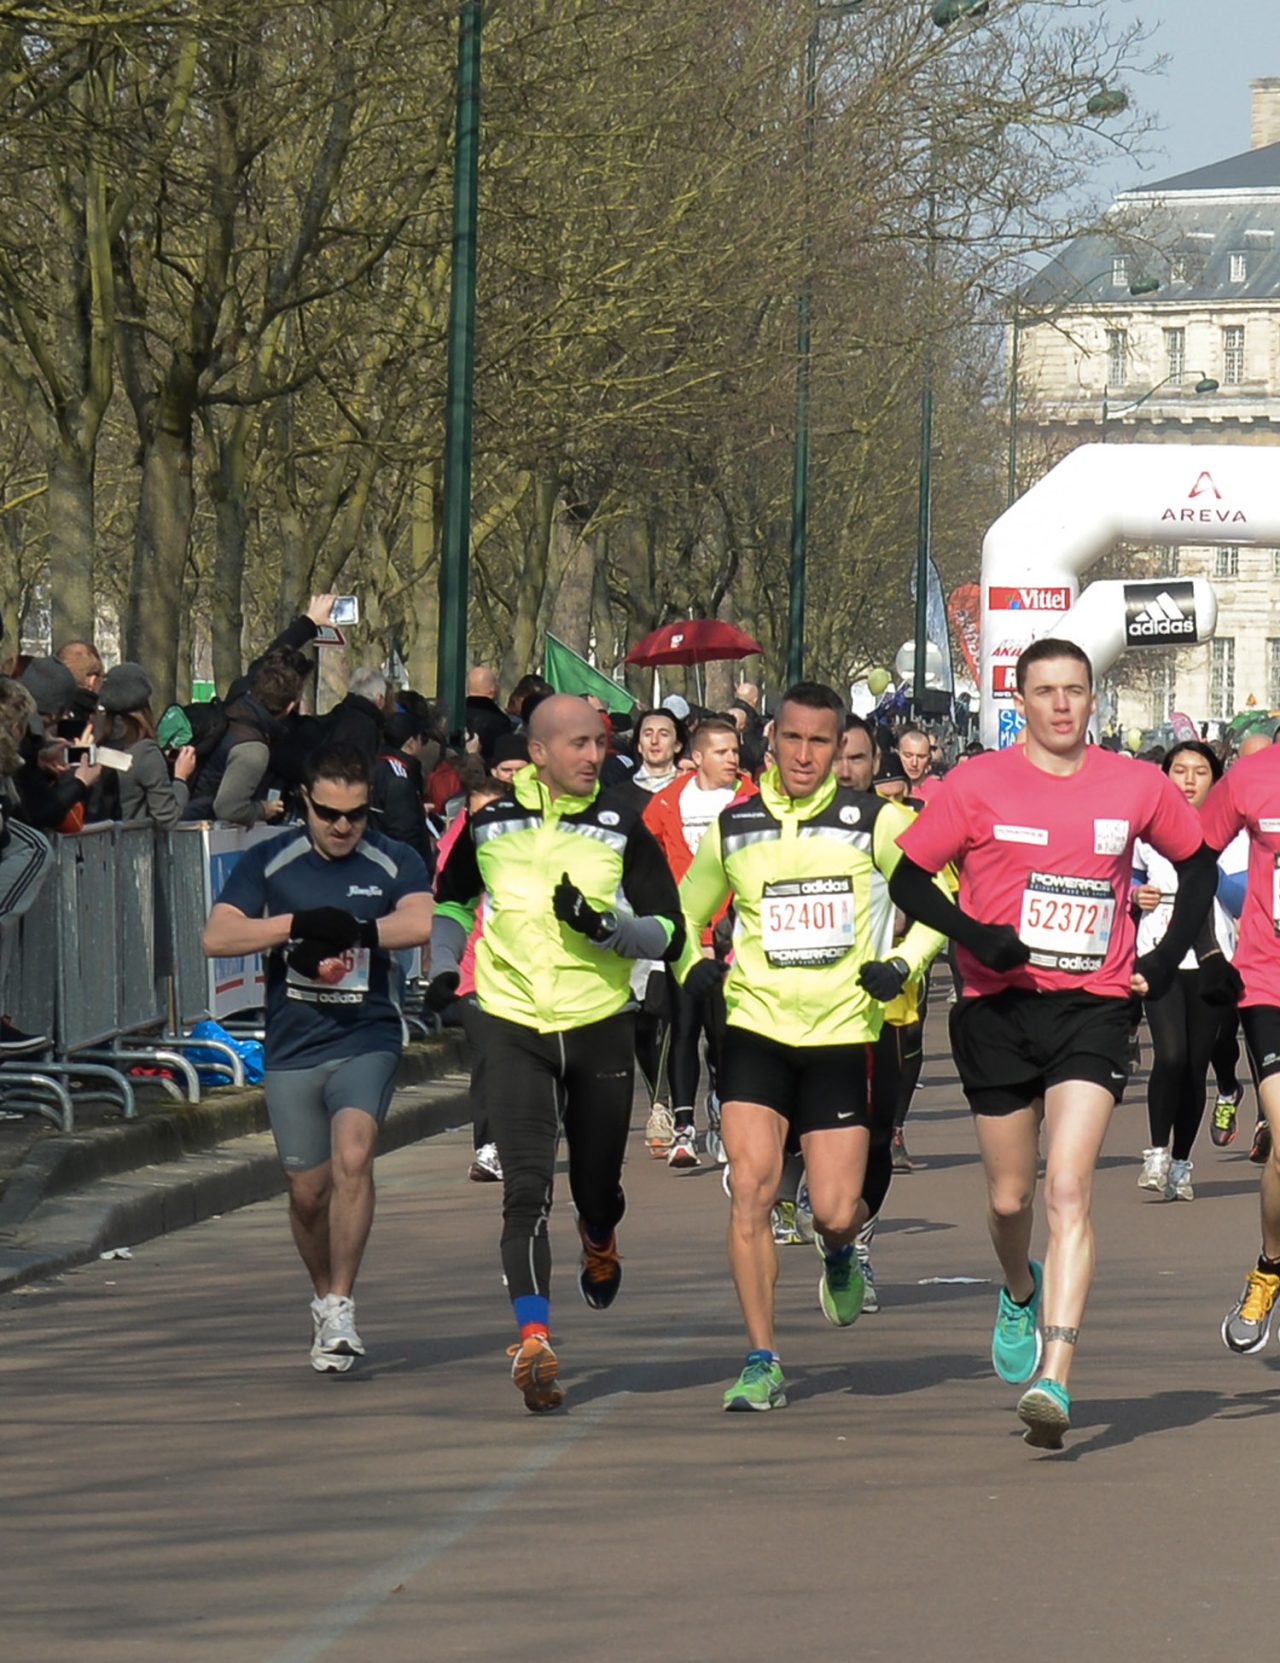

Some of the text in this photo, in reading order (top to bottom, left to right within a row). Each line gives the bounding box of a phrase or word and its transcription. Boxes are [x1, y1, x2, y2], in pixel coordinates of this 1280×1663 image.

[1161, 508, 1247, 523] AREVA
[1019, 588, 1067, 609] Vittel
[1128, 619, 1194, 636] adidas
[801, 880, 850, 894] adidas
[1031, 872, 1111, 892] POWERADE
[770, 901, 835, 932] 52401
[1027, 898, 1098, 935] 52372
[1058, 956, 1102, 972] adidas
